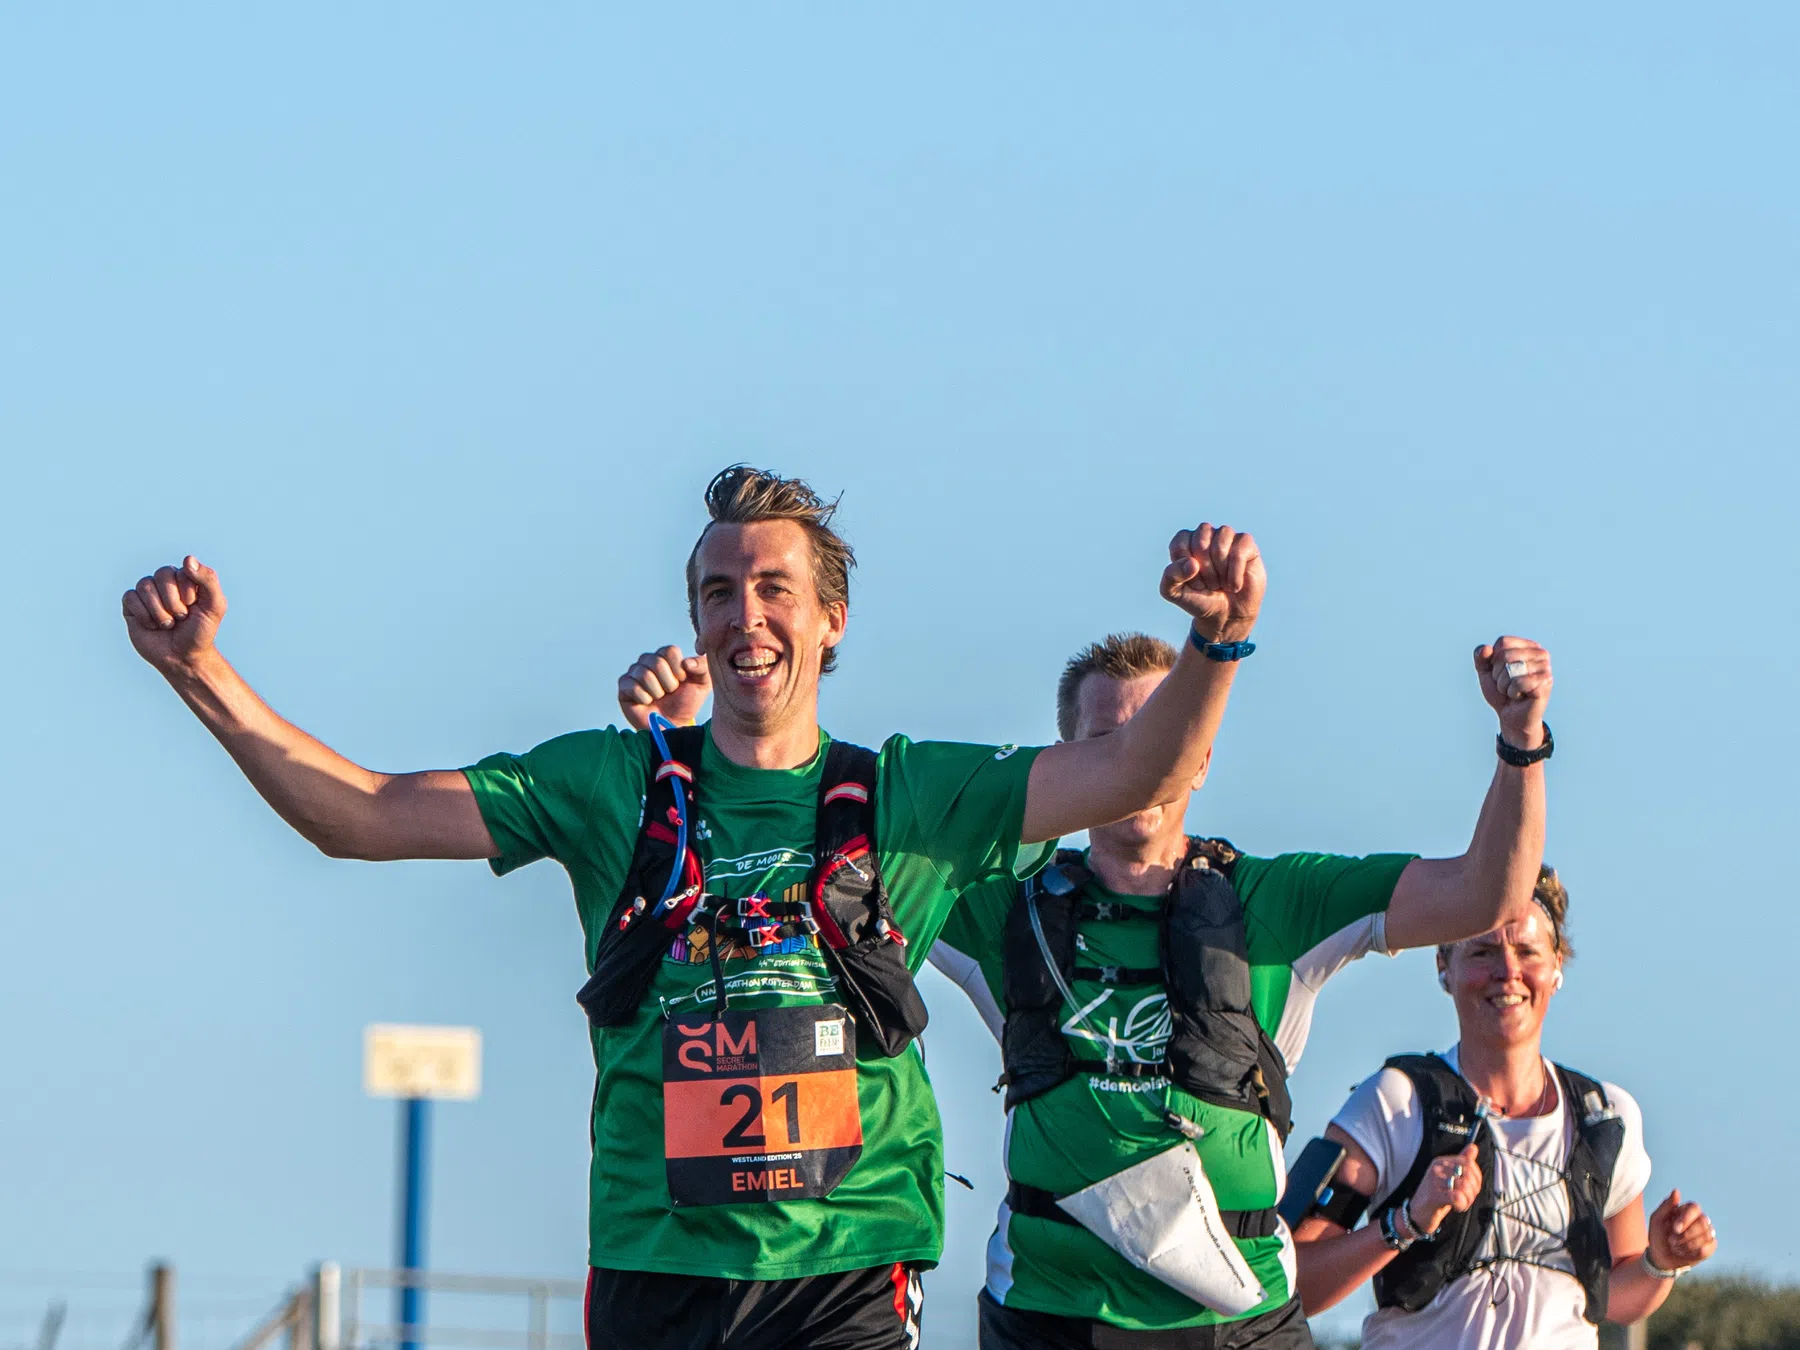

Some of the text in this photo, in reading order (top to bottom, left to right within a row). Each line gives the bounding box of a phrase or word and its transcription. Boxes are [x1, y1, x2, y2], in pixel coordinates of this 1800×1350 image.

[736, 859, 754, 871] DE
[701, 986, 716, 997] NN
[761, 977, 813, 990] ROTTERDAM
[717, 1056, 745, 1065] SECRET
[717, 1063, 758, 1072] MARATHON
[719, 1081, 801, 1149] 21
[731, 1155, 767, 1164] WESTLAND
[767, 1153, 792, 1162] EDITION
[731, 1168, 805, 1192] EMIEL
